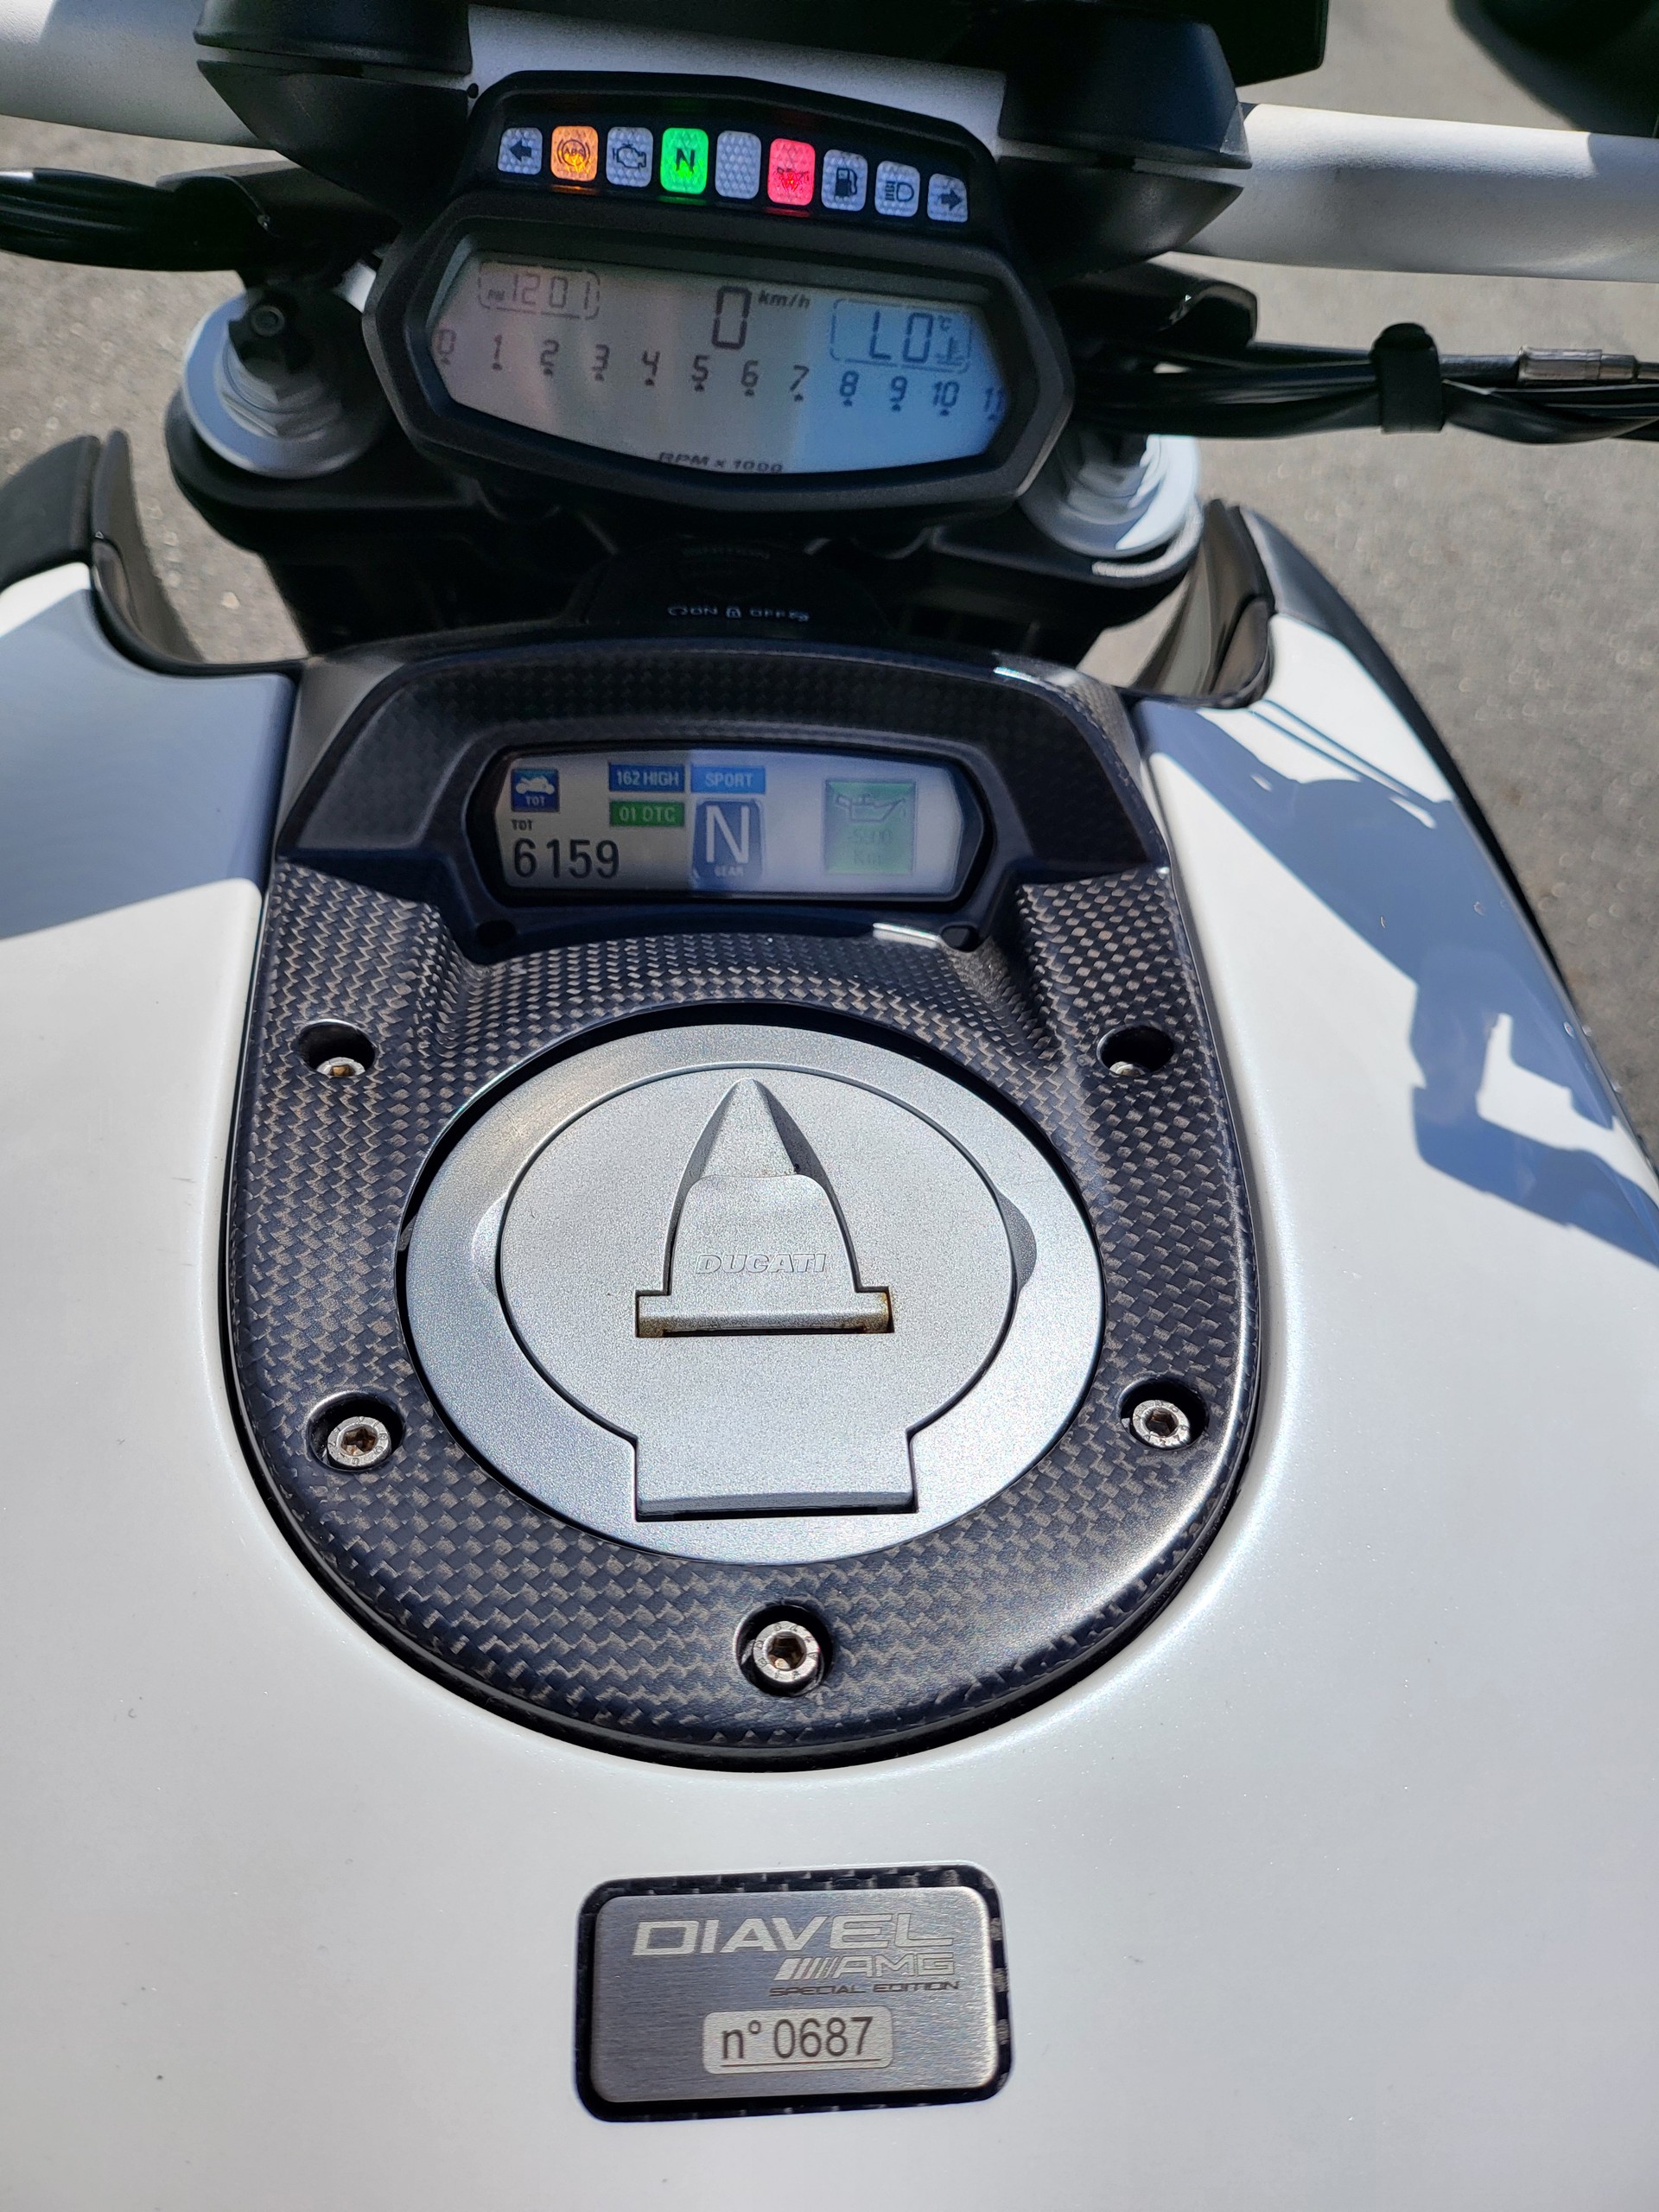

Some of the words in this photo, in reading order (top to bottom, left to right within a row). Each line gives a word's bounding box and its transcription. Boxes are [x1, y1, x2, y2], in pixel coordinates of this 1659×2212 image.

[674, 149, 696, 173] N
[512, 272, 591, 309] 1201
[712, 286, 751, 349] 0
[758, 290, 810, 309] km/h
[493, 334, 502, 359] 1
[540, 339, 559, 366] 2
[592, 344, 610, 370] 3
[641, 351, 659, 377] 4
[692, 354, 710, 383] 5
[741, 359, 759, 387] 6
[790, 365, 810, 391] 7
[839, 370, 860, 397] 8
[890, 375, 908, 402] 9
[932, 380, 959, 408] 10
[659, 452, 709, 466] RPM
[734, 460, 783, 473] 1000
[616, 770, 640, 786] 162
[643, 772, 679, 786] HIGH
[705, 772, 753, 787] SPORT
[525, 796, 546, 806] TOT
[512, 819, 532, 830] TOT
[705, 804, 751, 863] N
[514, 838, 620, 880] 6159
[696, 1253, 826, 1274] DUCATI
[632, 1912, 954, 1956] DIAVEL
[834, 1953, 957, 1978] AMG
[769, 1986, 866, 1997] SPECIAL
[874, 1980, 959, 1993] EDITION
[773, 2016, 874, 2058] 0687
